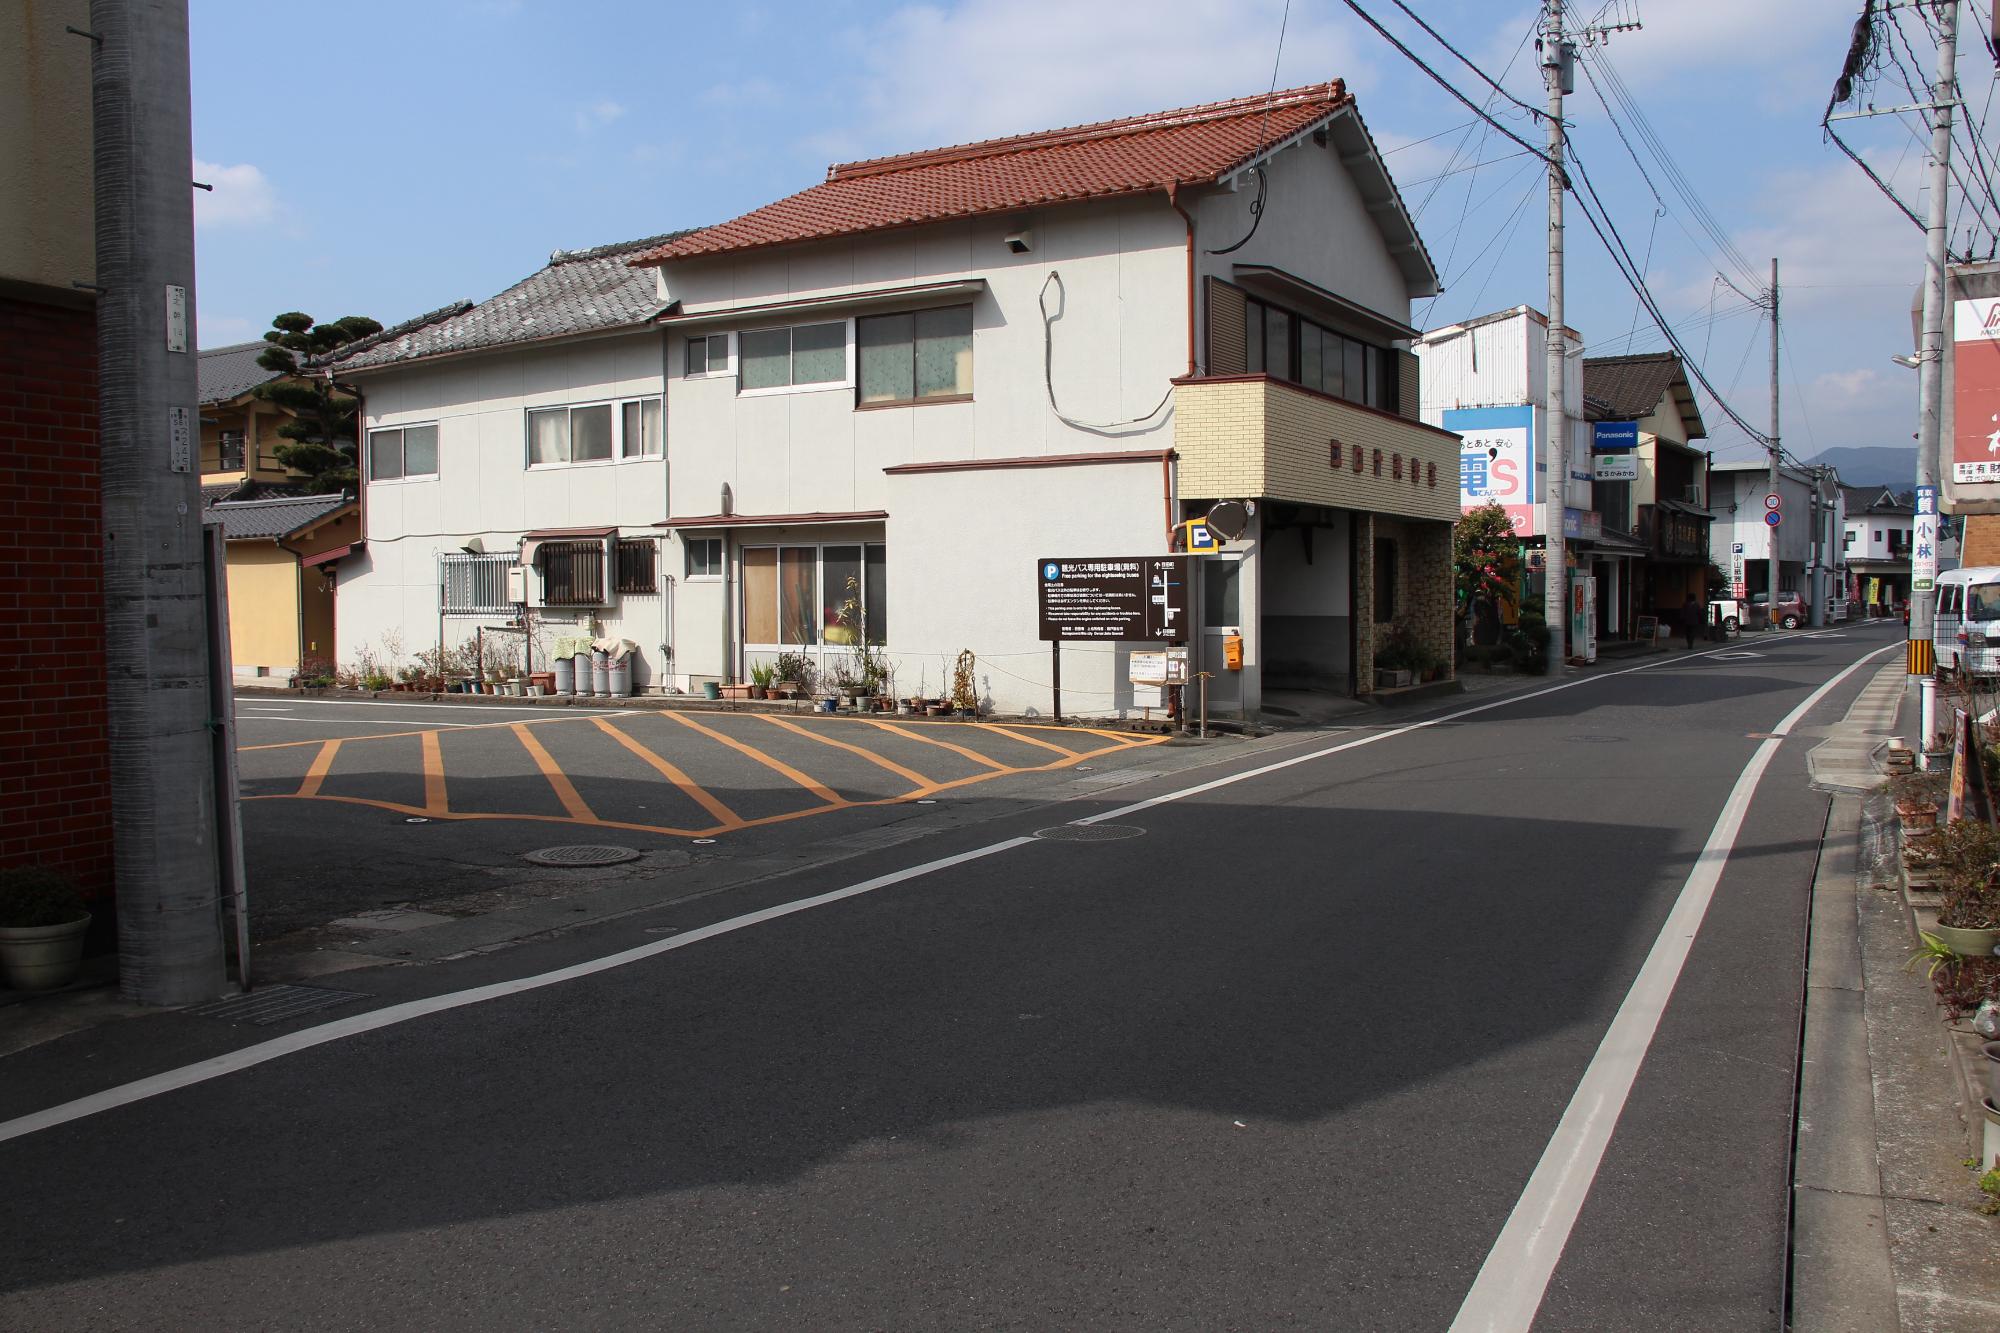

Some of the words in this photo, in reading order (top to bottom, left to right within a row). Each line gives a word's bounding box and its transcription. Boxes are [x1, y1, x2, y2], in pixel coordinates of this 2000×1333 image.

[1597, 431, 1634, 439] Panasonic
[1495, 438, 1513, 448] 安心
[1917, 497, 1933, 514] 質
[1193, 528, 1212, 546] P
[1916, 521, 1932, 559] 小林
[1047, 565, 1057, 578] P
